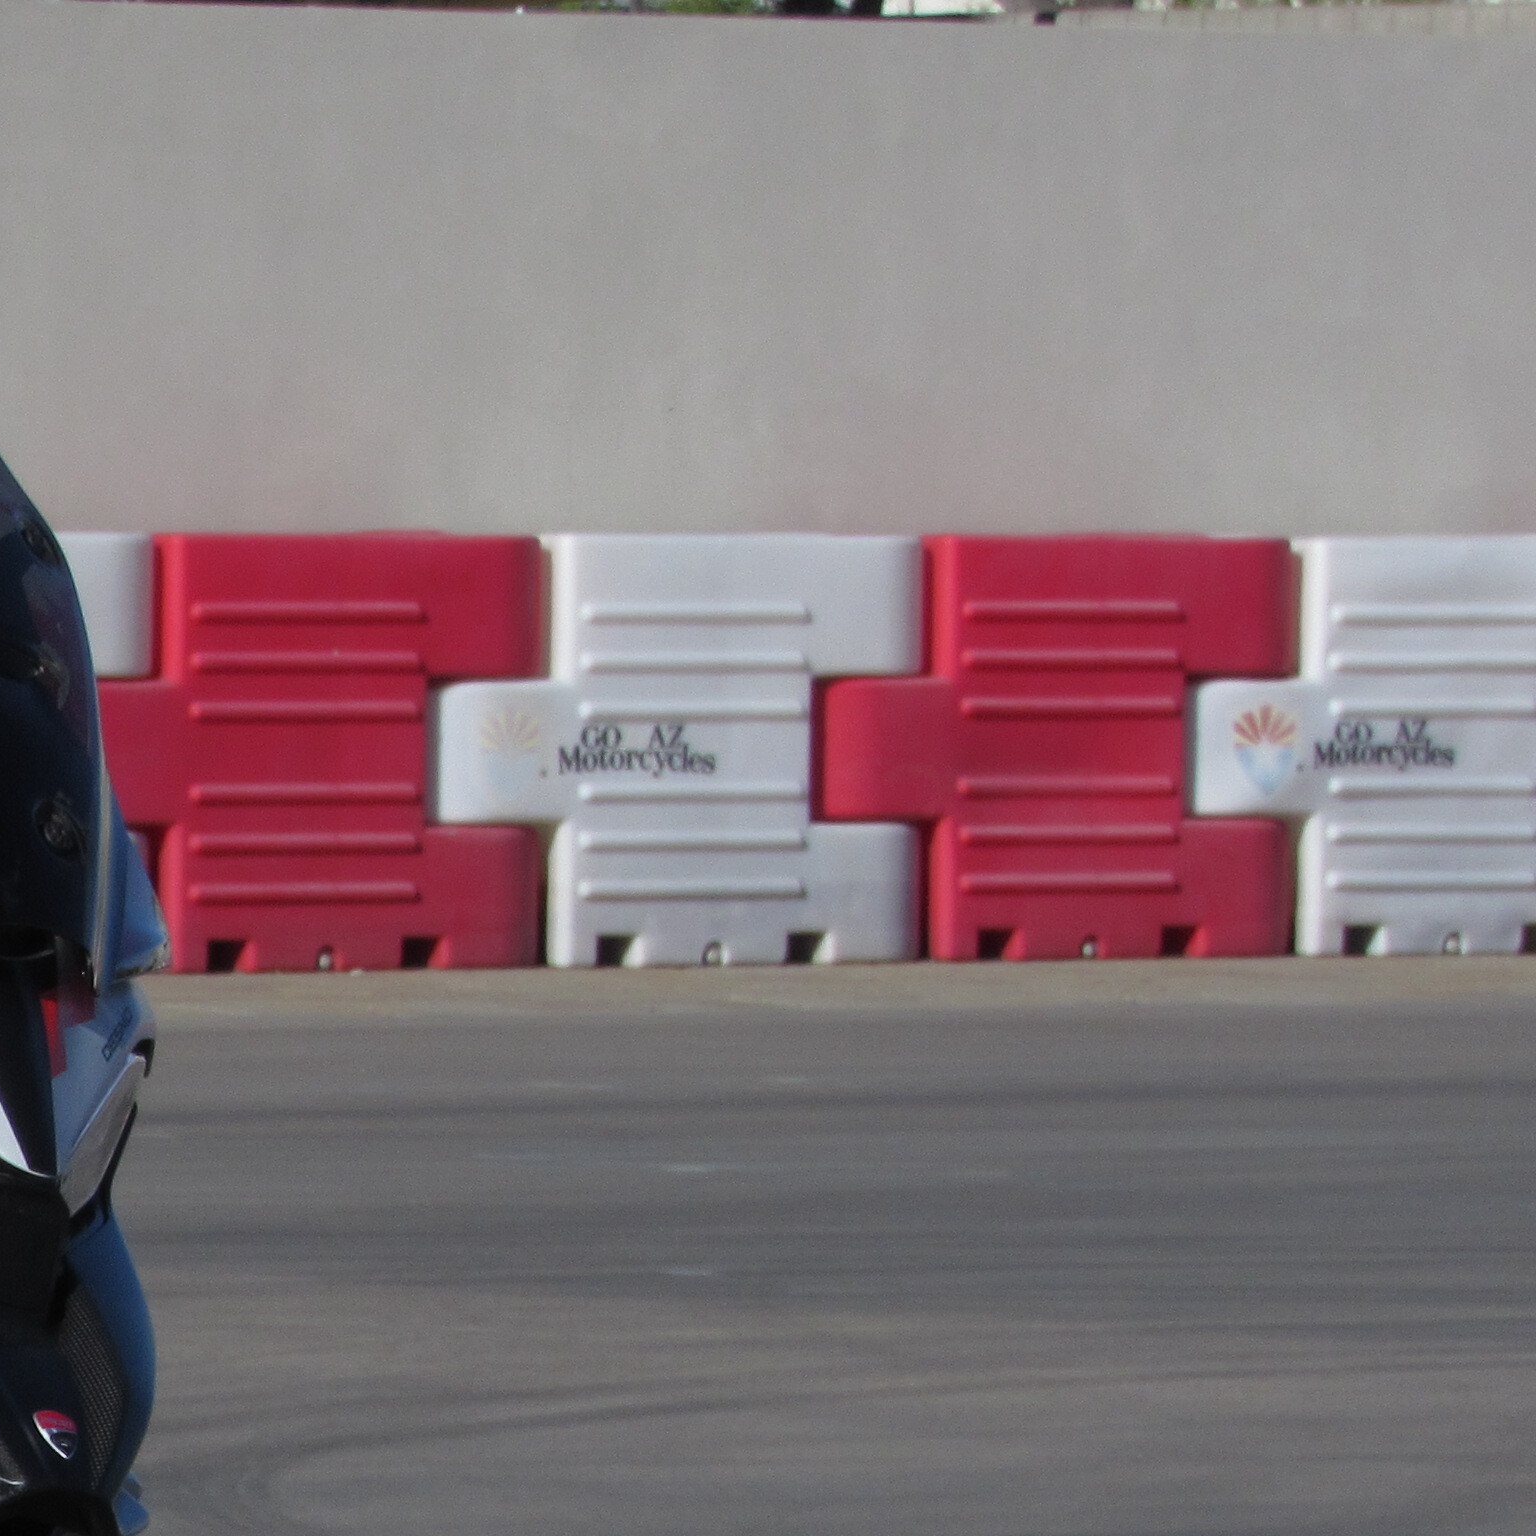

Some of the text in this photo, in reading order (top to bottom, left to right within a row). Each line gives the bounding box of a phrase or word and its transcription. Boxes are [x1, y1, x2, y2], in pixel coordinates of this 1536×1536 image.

[581, 723, 686, 749] GO AZ
[557, 744, 717, 778] Motorcycles
